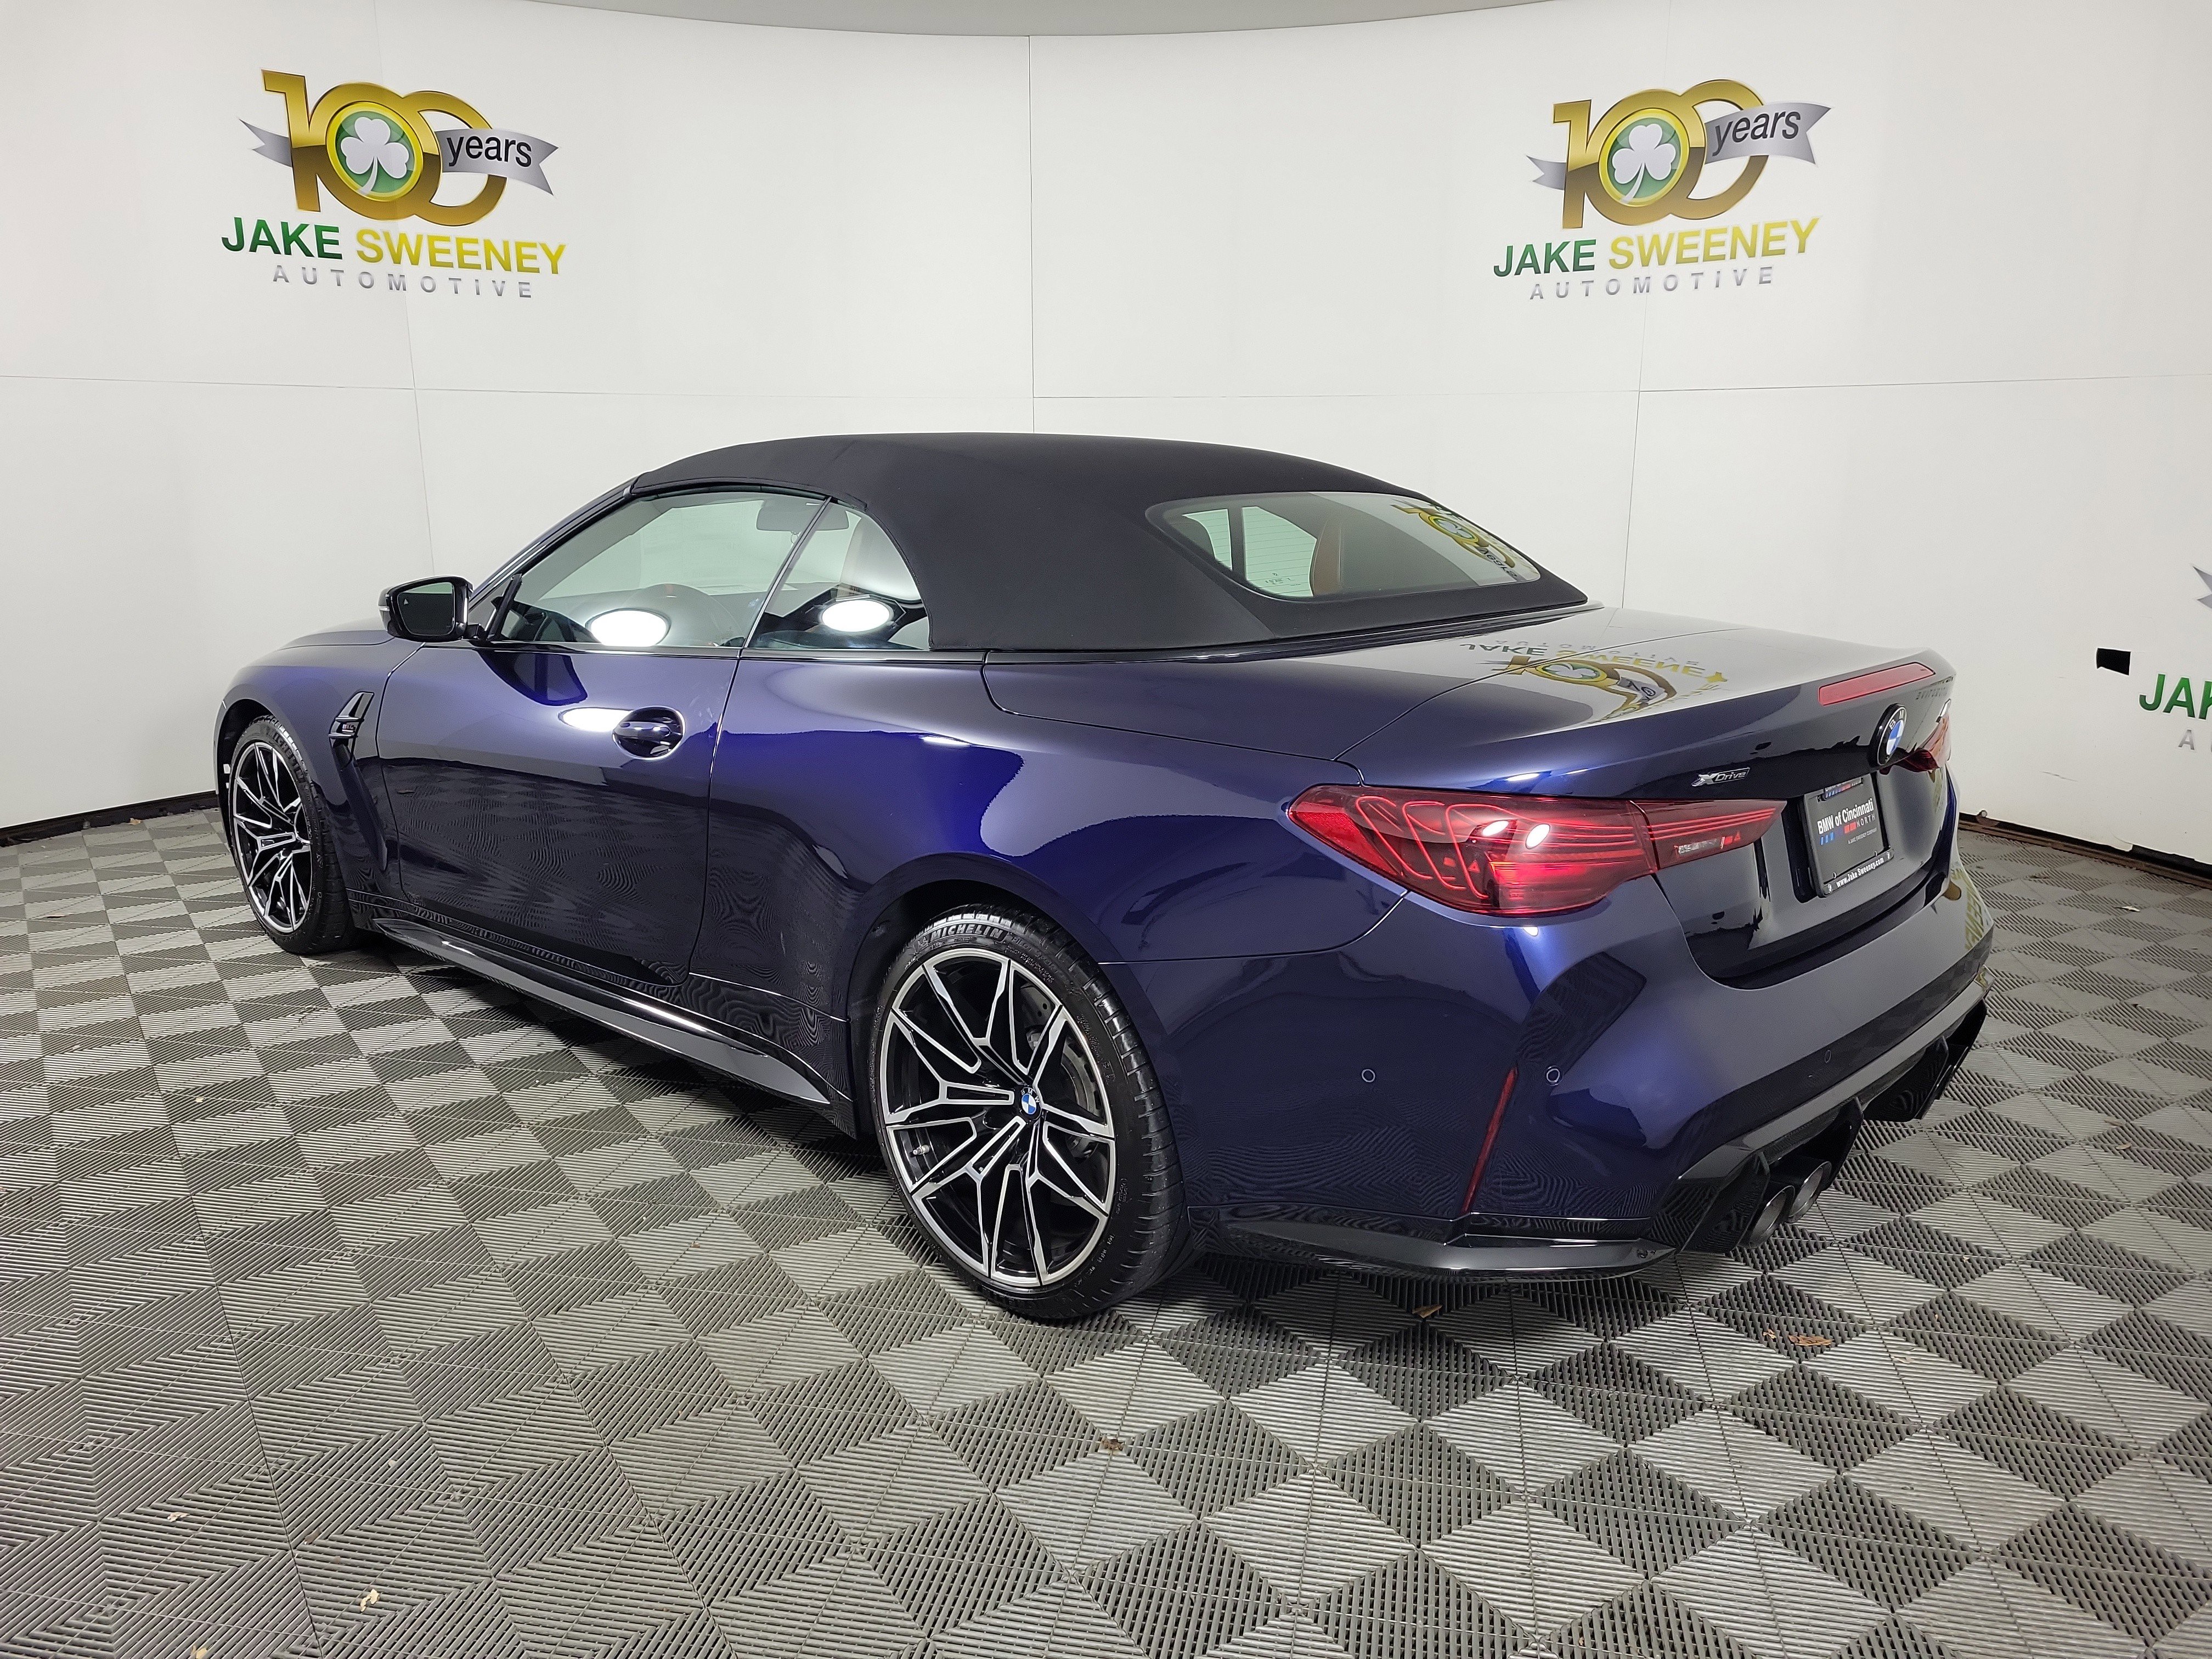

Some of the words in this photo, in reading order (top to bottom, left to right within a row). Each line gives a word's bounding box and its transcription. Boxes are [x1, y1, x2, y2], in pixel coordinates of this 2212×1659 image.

[262, 69, 506, 227] 100
[1712, 108, 1801, 156] years
[446, 134, 532, 167] years
[1553, 78, 1769, 230] 100
[221, 217, 342, 260] JAKE
[356, 229, 566, 275] SWEENEY
[1493, 239, 1596, 277] JAKE
[1609, 217, 1820, 270] SWEENEY
[273, 265, 532, 298] AUTOMOTIVE
[1530, 266, 1773, 300] AUTOMOTIVE
[1817, 815, 1833, 834] BMW
[1835, 811, 1842, 826] of
[1842, 798, 1874, 822] Cincinnati
[1857, 813, 1876, 828] NORTH
[932, 924, 1004, 939] MICHELIN
